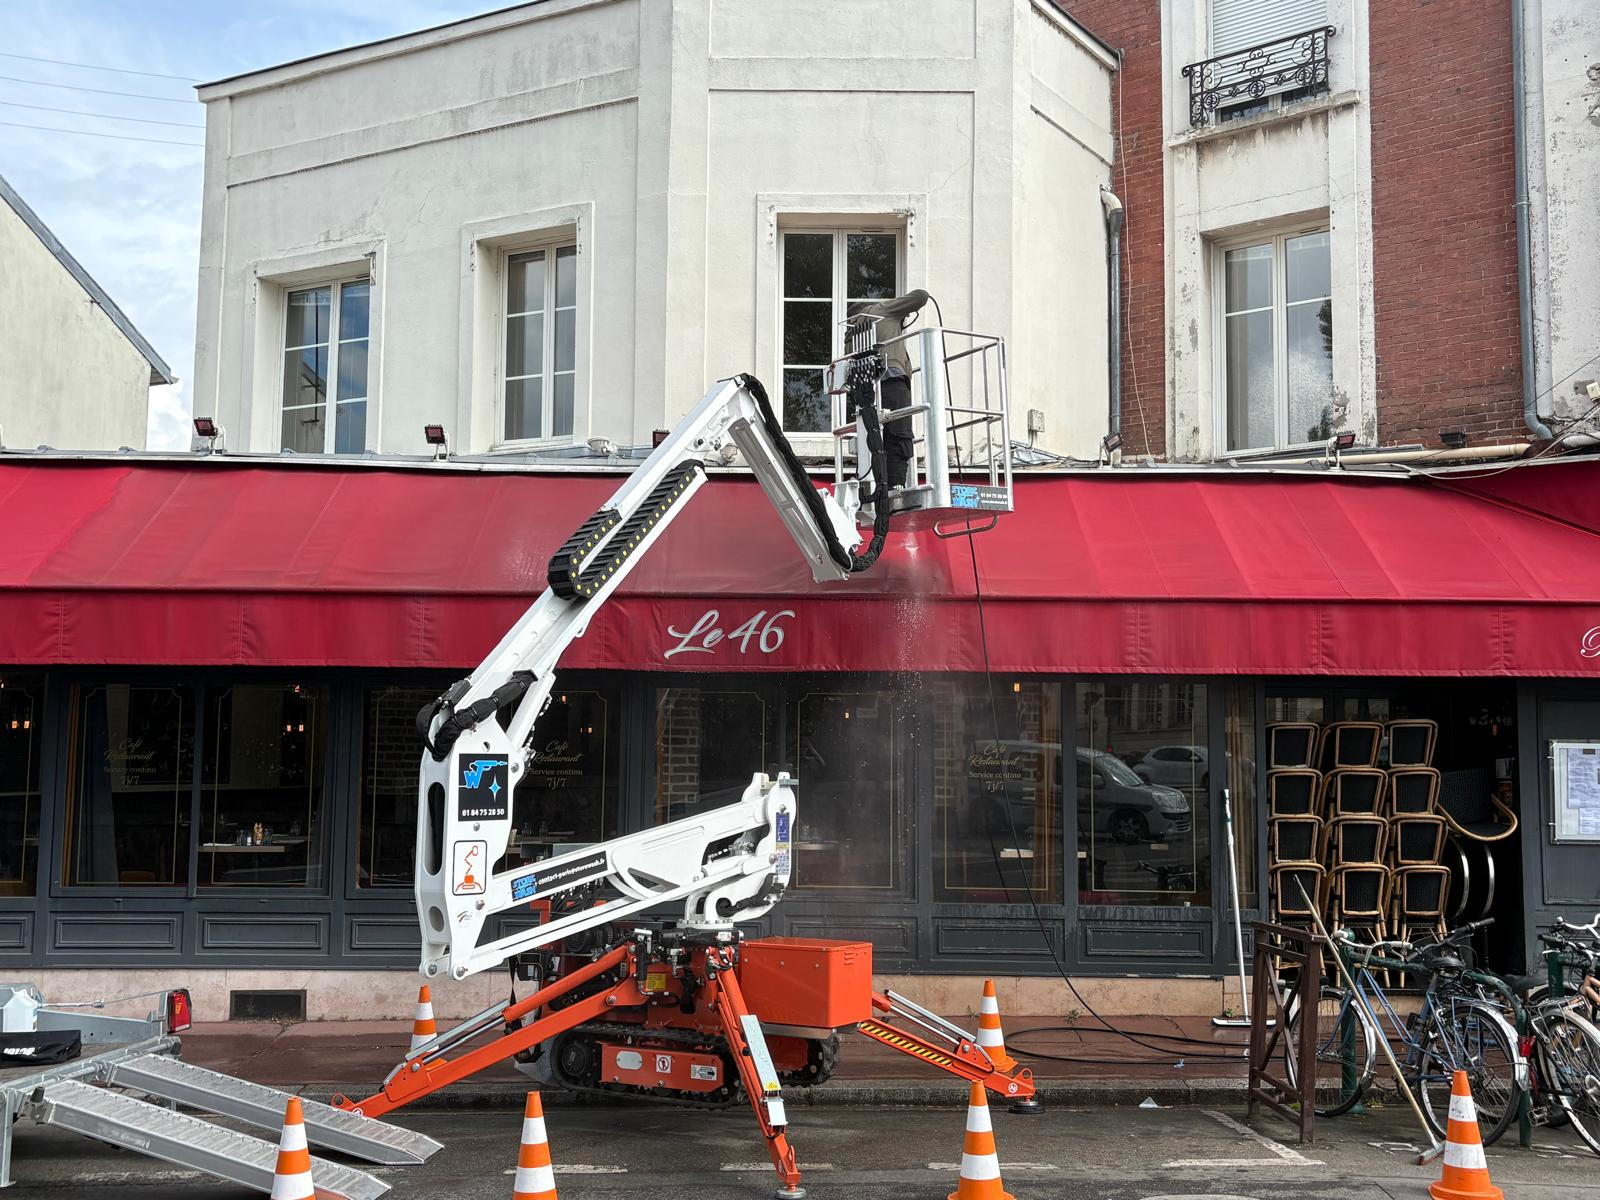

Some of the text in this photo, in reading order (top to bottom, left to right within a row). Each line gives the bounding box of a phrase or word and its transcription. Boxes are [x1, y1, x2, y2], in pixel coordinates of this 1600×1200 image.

[664, 609, 796, 660] Le 46
[531, 751, 585, 764] Restaurant
[529, 767, 555, 775] Service
[546, 777, 567, 790] 7j/7
[462, 809, 470, 817] 01
[488, 808, 497, 816] 28
